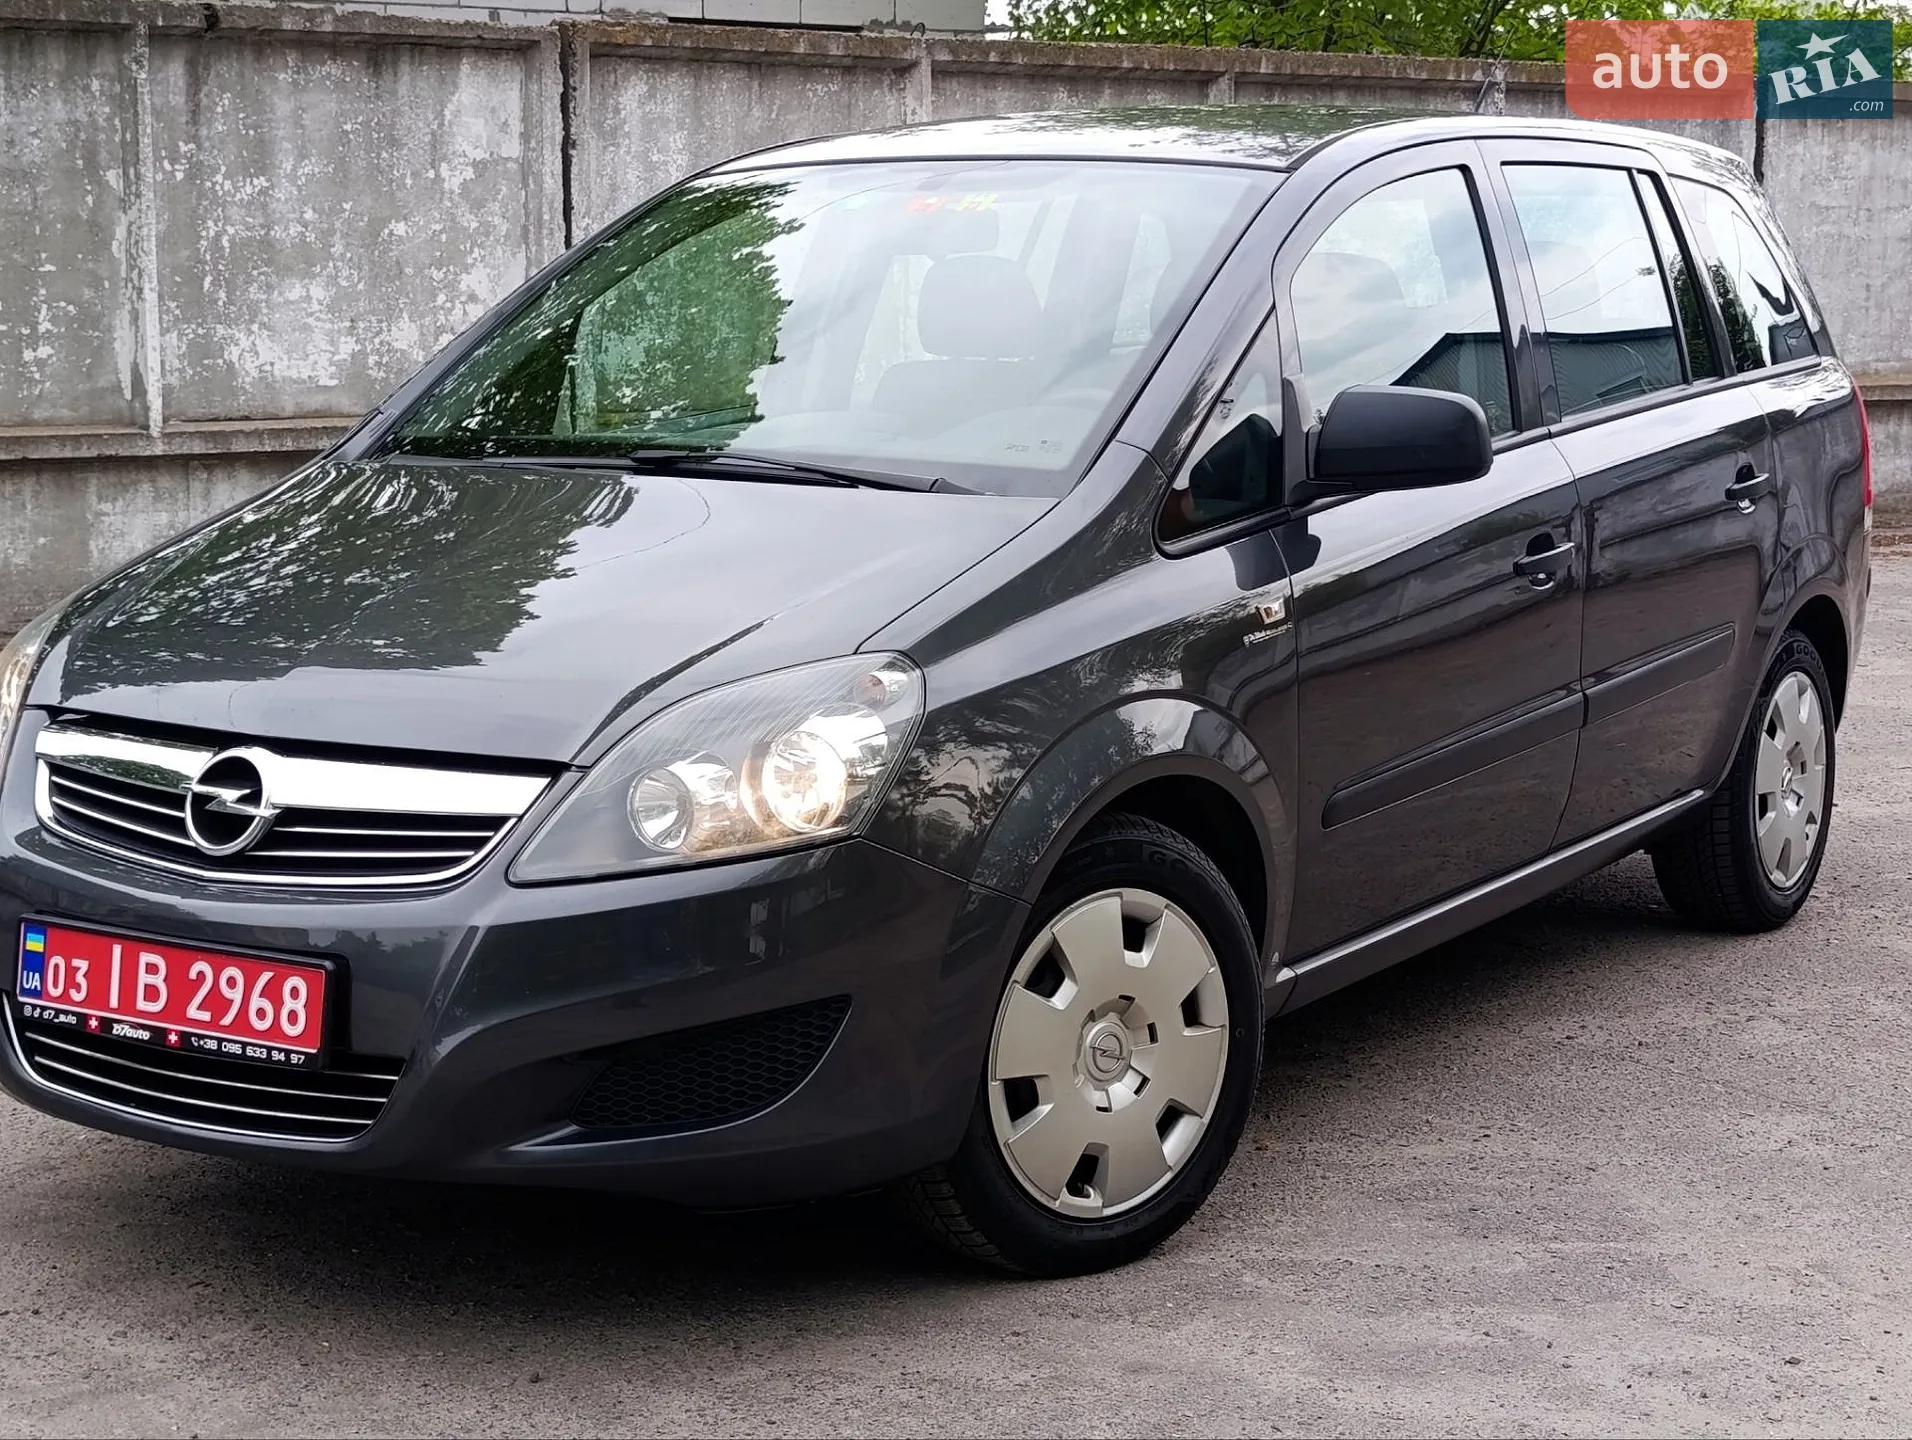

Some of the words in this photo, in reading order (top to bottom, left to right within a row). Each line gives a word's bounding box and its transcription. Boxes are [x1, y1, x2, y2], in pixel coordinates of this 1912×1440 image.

[23, 970, 42, 991] UA
[47, 955, 90, 1003] 03
[186, 961, 308, 1037] 2968
[200, 1039, 218, 1050] +38
[221, 1042, 243, 1055] 095
[271, 1050, 286, 1062] 94
[290, 1053, 306, 1065] 97
